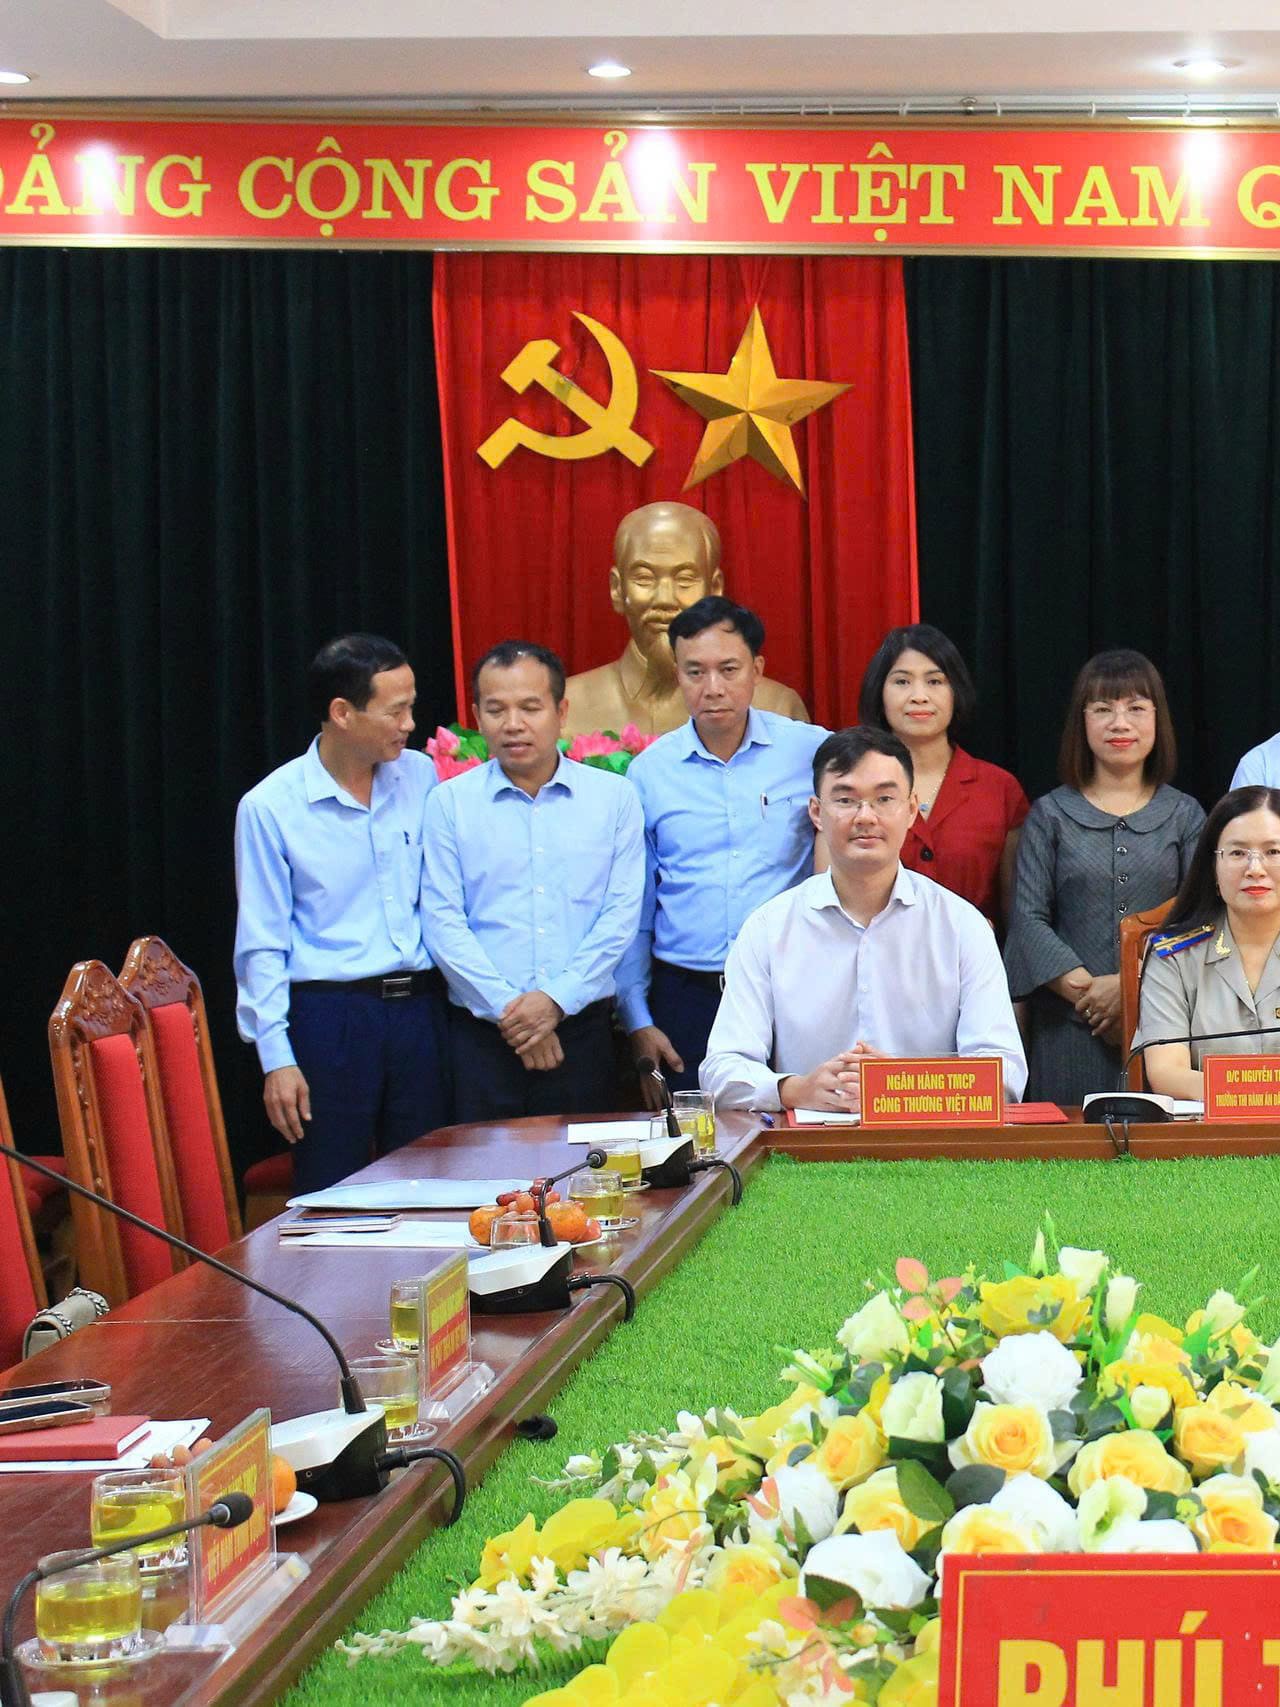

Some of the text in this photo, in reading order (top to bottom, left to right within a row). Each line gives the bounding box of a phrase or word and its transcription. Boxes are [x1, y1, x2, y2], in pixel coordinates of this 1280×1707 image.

[0, 122, 212, 218] ẢNG
[238, 136, 500, 236] CỘNG
[525, 130, 717, 223] SẢN
[746, 142, 965, 242] VIỆT
[992, 165, 1211, 227] NAM
[886, 1070, 976, 1091] NGÂN HÀNG TMCP
[873, 1094, 900, 1113] CÔNG
[946, 1093, 967, 1115] VIỆT
[969, 1095, 993, 1112] NAM
